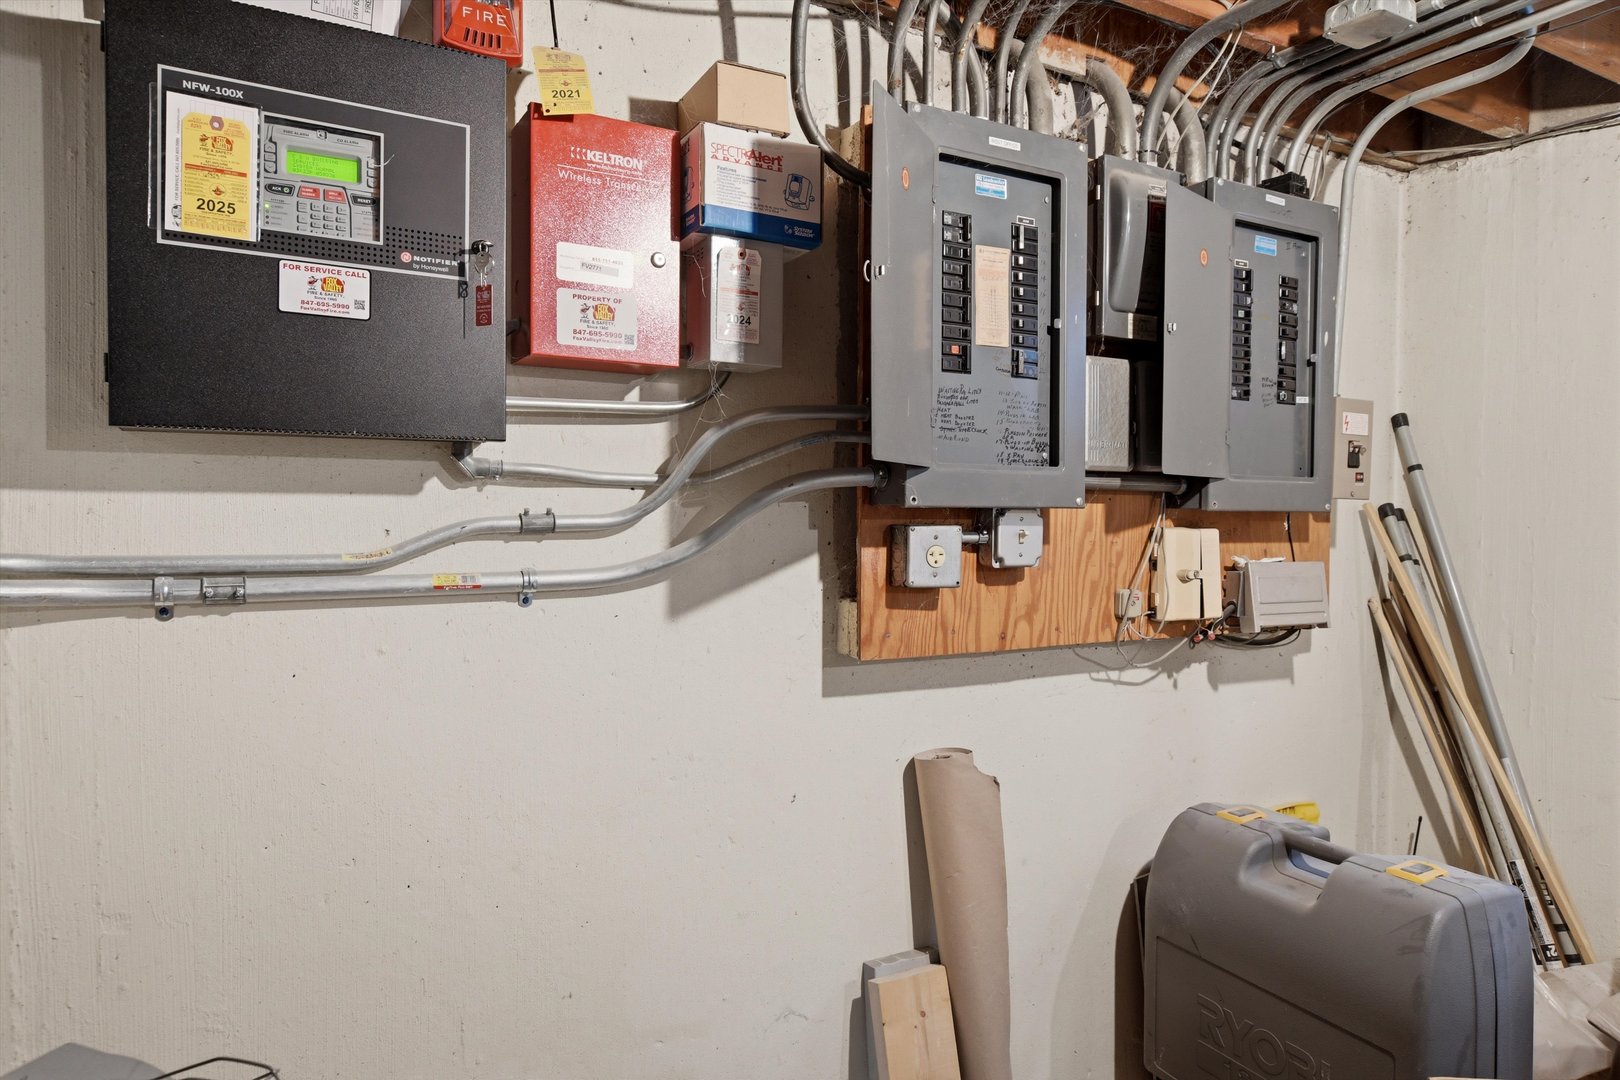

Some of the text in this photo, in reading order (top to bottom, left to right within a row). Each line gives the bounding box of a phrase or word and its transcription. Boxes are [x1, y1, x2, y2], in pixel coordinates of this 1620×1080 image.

[462, 6, 507, 27] FIRE
[182, 80, 244, 99] NFW-100X
[551, 89, 581, 99] 2021
[586, 149, 644, 171] KELTRON
[558, 170, 602, 187] Wireless
[196, 198, 236, 215] 2025
[413, 255, 458, 266] NOTIFIER
[282, 263, 367, 279] FOR SERVICE CALL
[421, 263, 449, 272] Honeywell
[326, 277, 337, 285] FOX
[323, 284, 343, 292] VALLEY
[572, 293, 611, 303] PROPERTY
[300, 300, 350, 310] 847-695-5990
[597, 304, 609, 313] FOX
[595, 312, 614, 321] VALLEY
[572, 328, 623, 339] 847-695-5990
